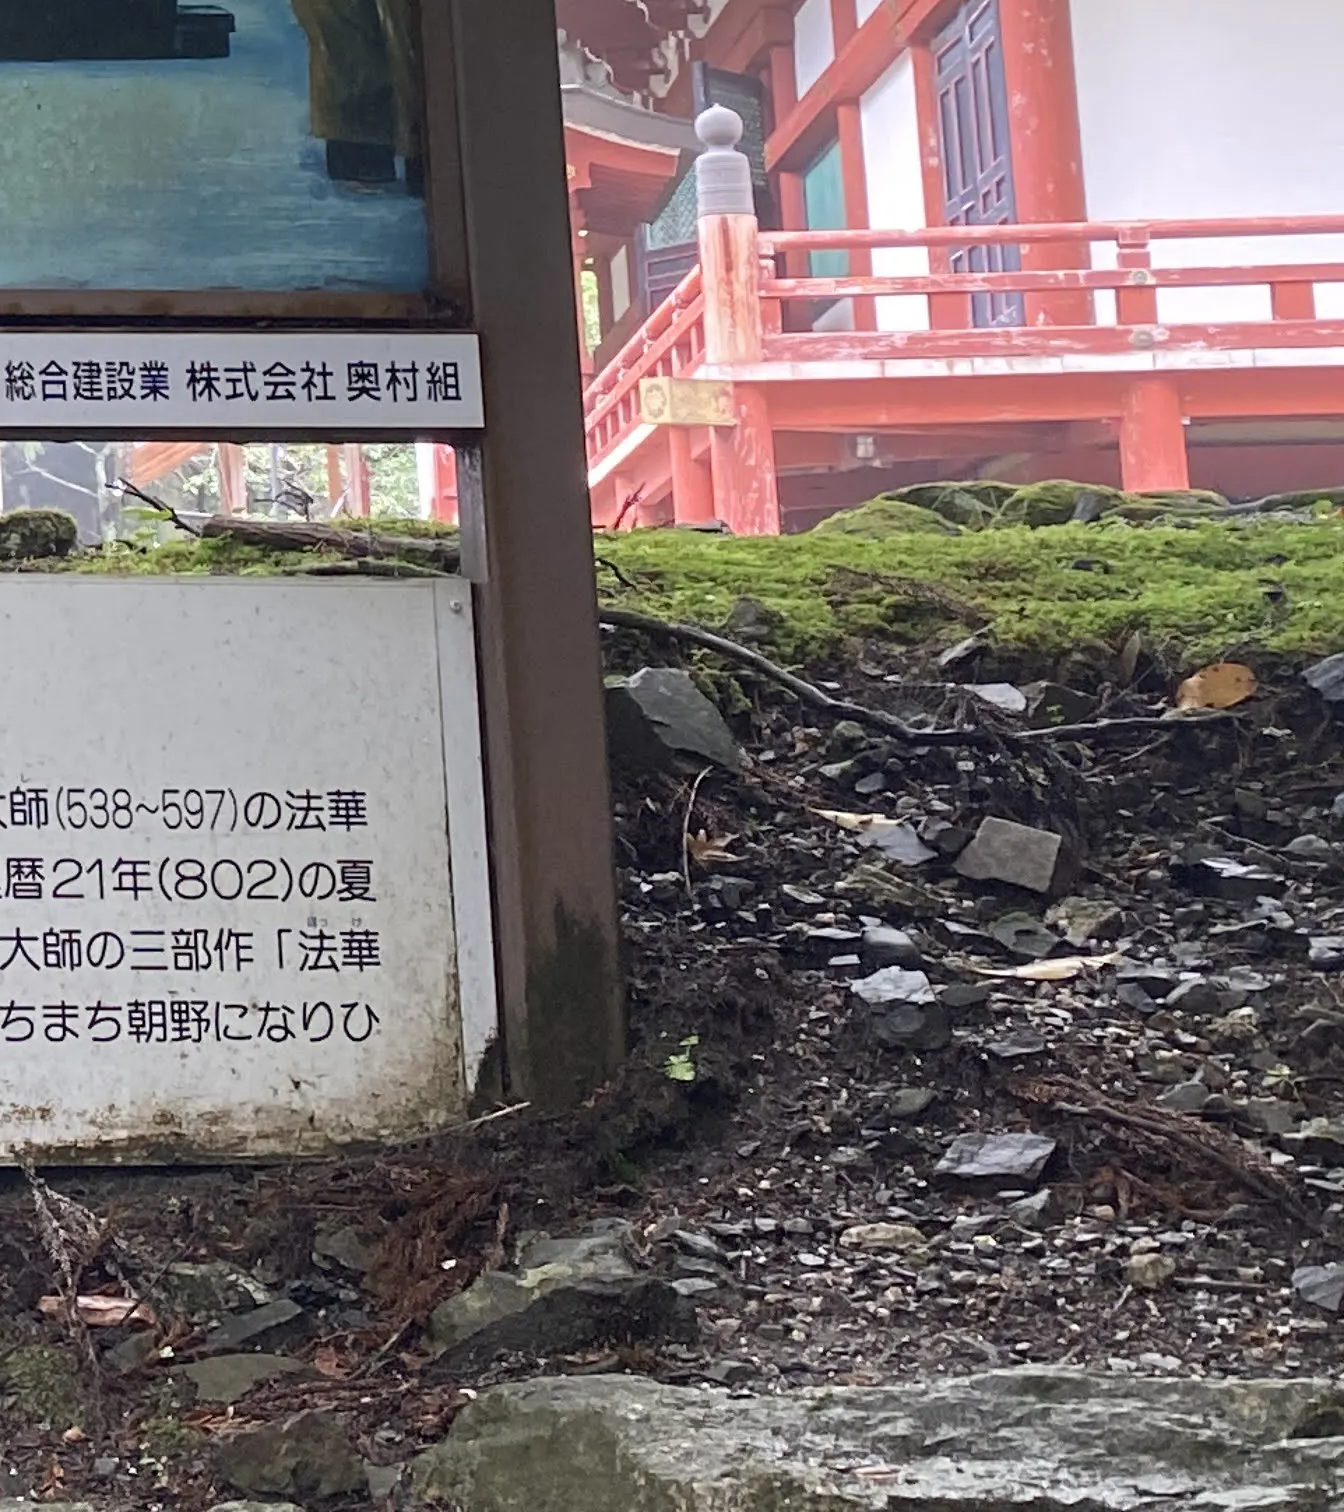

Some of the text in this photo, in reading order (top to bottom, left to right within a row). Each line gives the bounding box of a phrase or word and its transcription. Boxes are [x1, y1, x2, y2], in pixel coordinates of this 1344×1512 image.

[4, 359, 170, 402] 総合建設業
